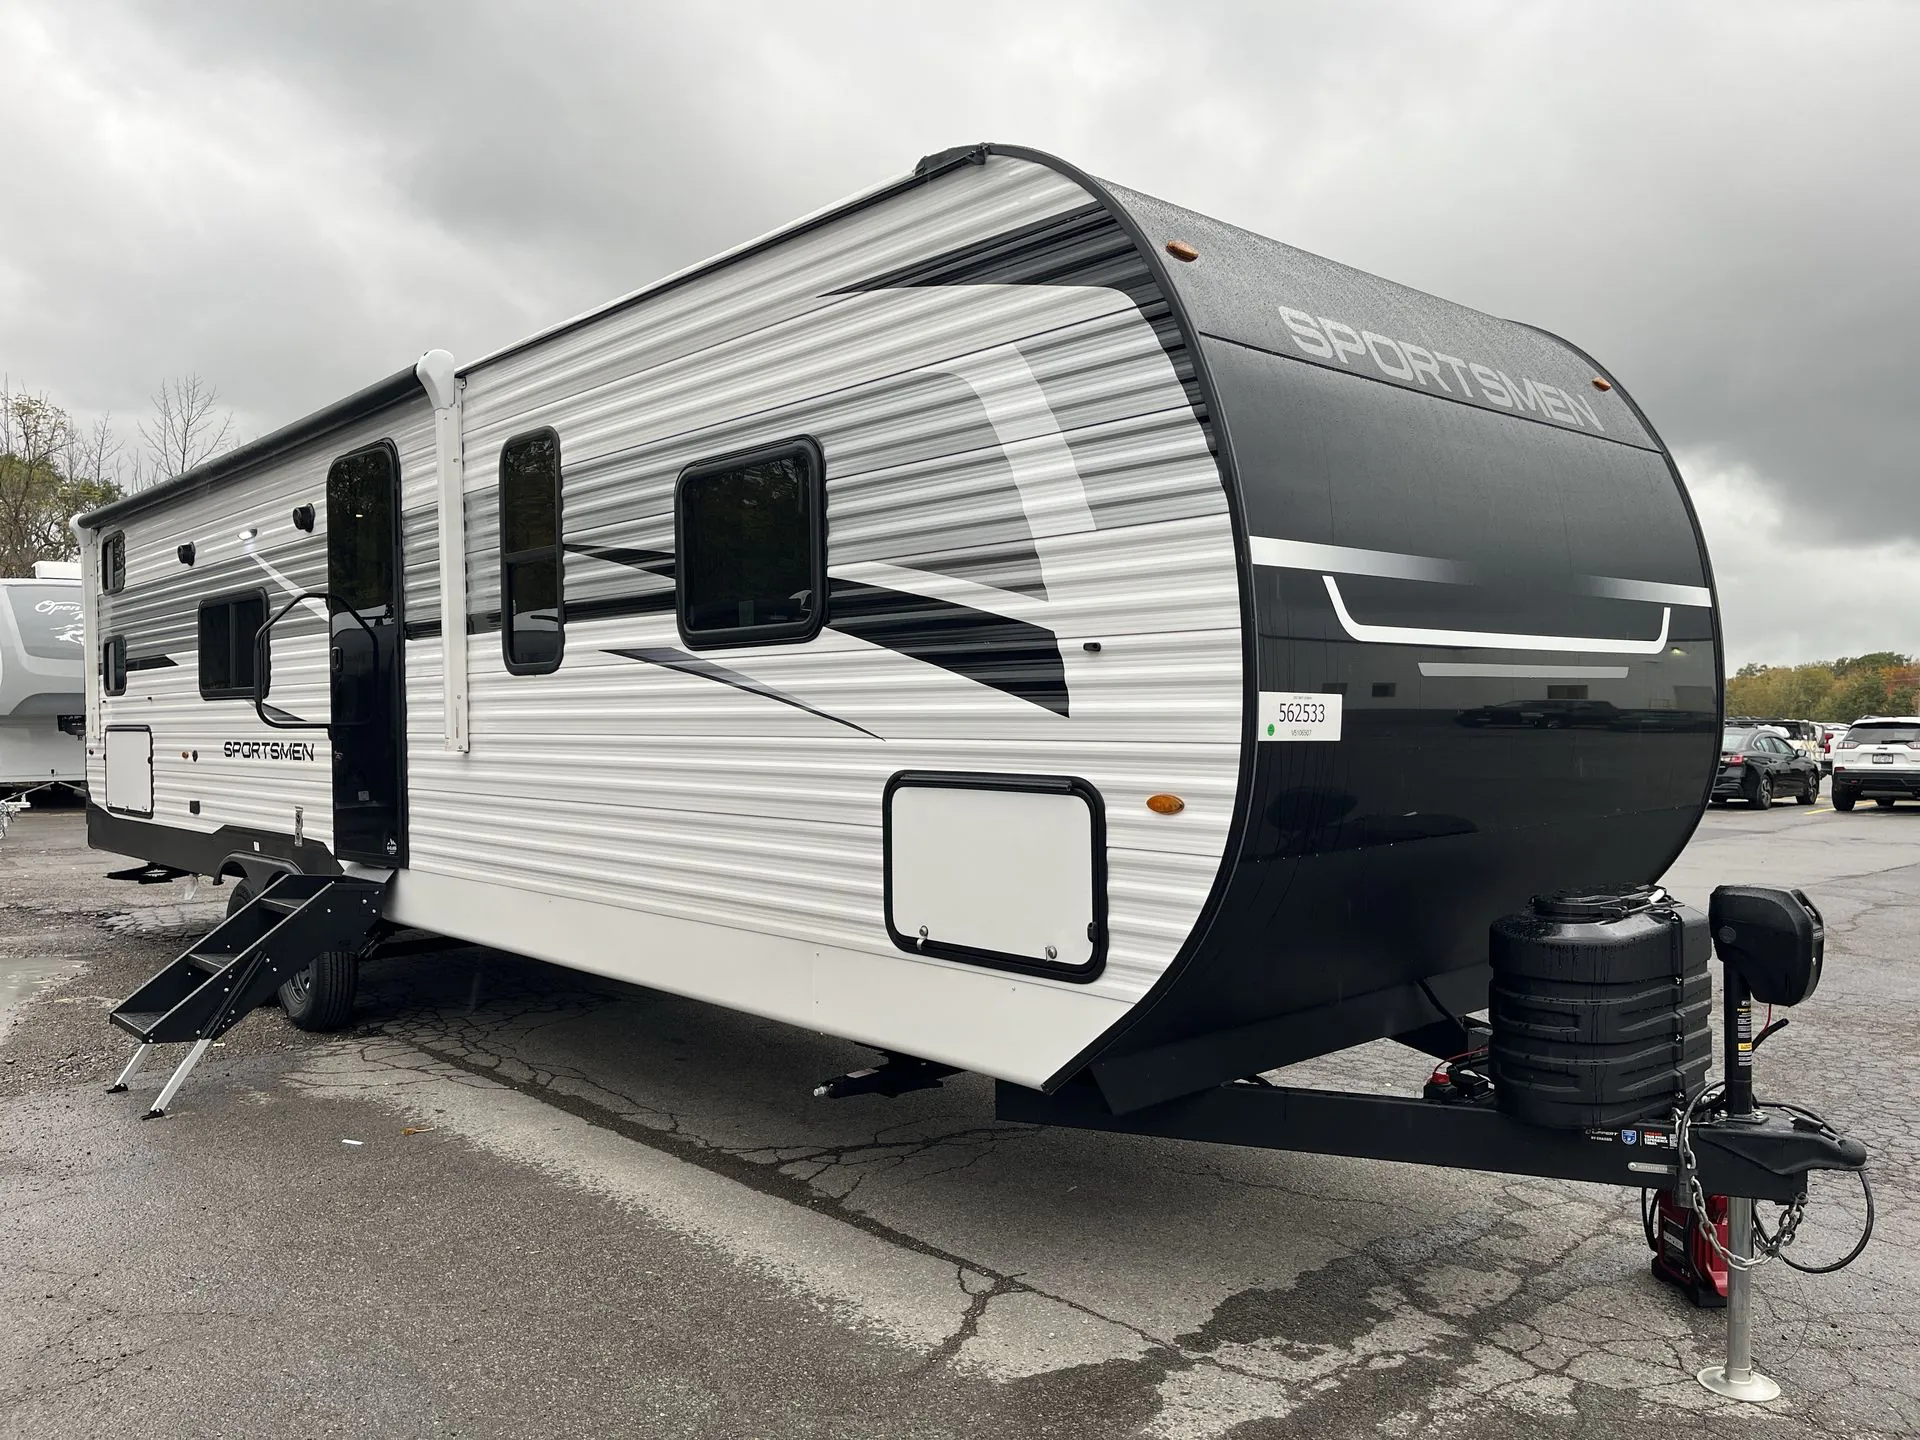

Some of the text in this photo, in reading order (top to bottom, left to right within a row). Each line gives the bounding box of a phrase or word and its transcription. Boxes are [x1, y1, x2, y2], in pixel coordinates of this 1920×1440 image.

[1278, 305, 1605, 432] SPORTSMEN
[1279, 703, 1325, 722] 562533
[223, 741, 315, 761] SPORTSMEN
